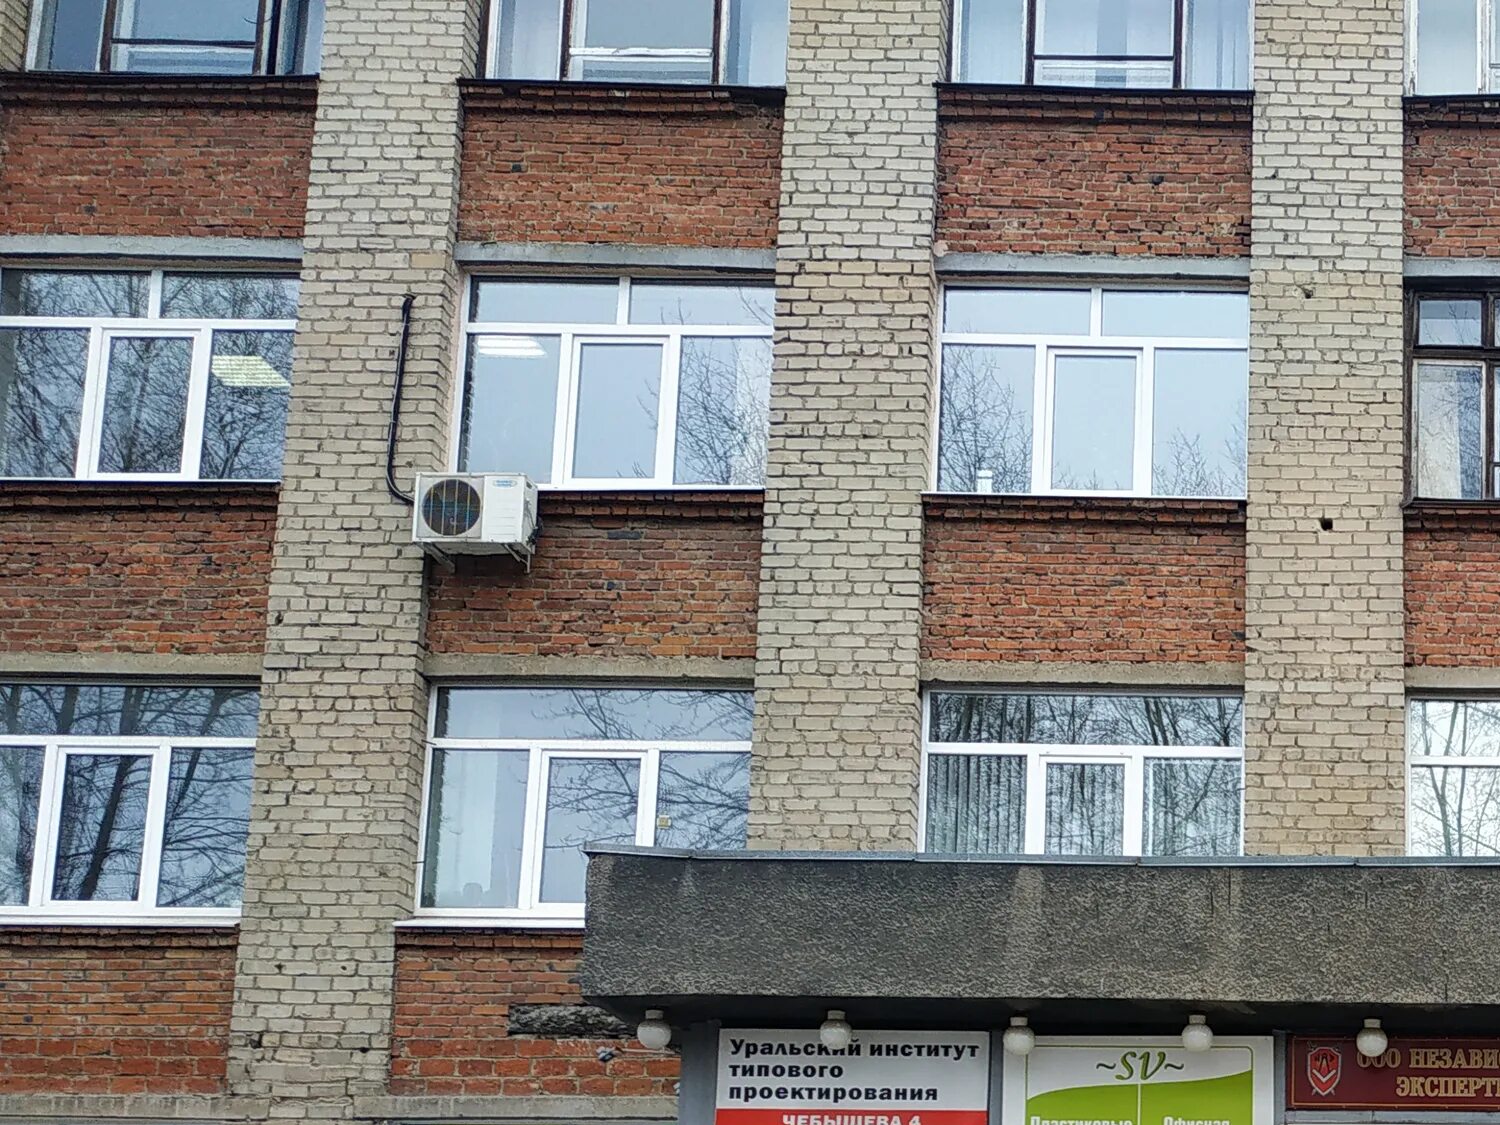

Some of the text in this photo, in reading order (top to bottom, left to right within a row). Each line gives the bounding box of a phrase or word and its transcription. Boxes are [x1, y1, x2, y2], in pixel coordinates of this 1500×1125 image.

[729, 1038, 979, 1061] Уральский институт
[729, 1064, 844, 1078] типового
[729, 1086, 938, 1103] проектирования
